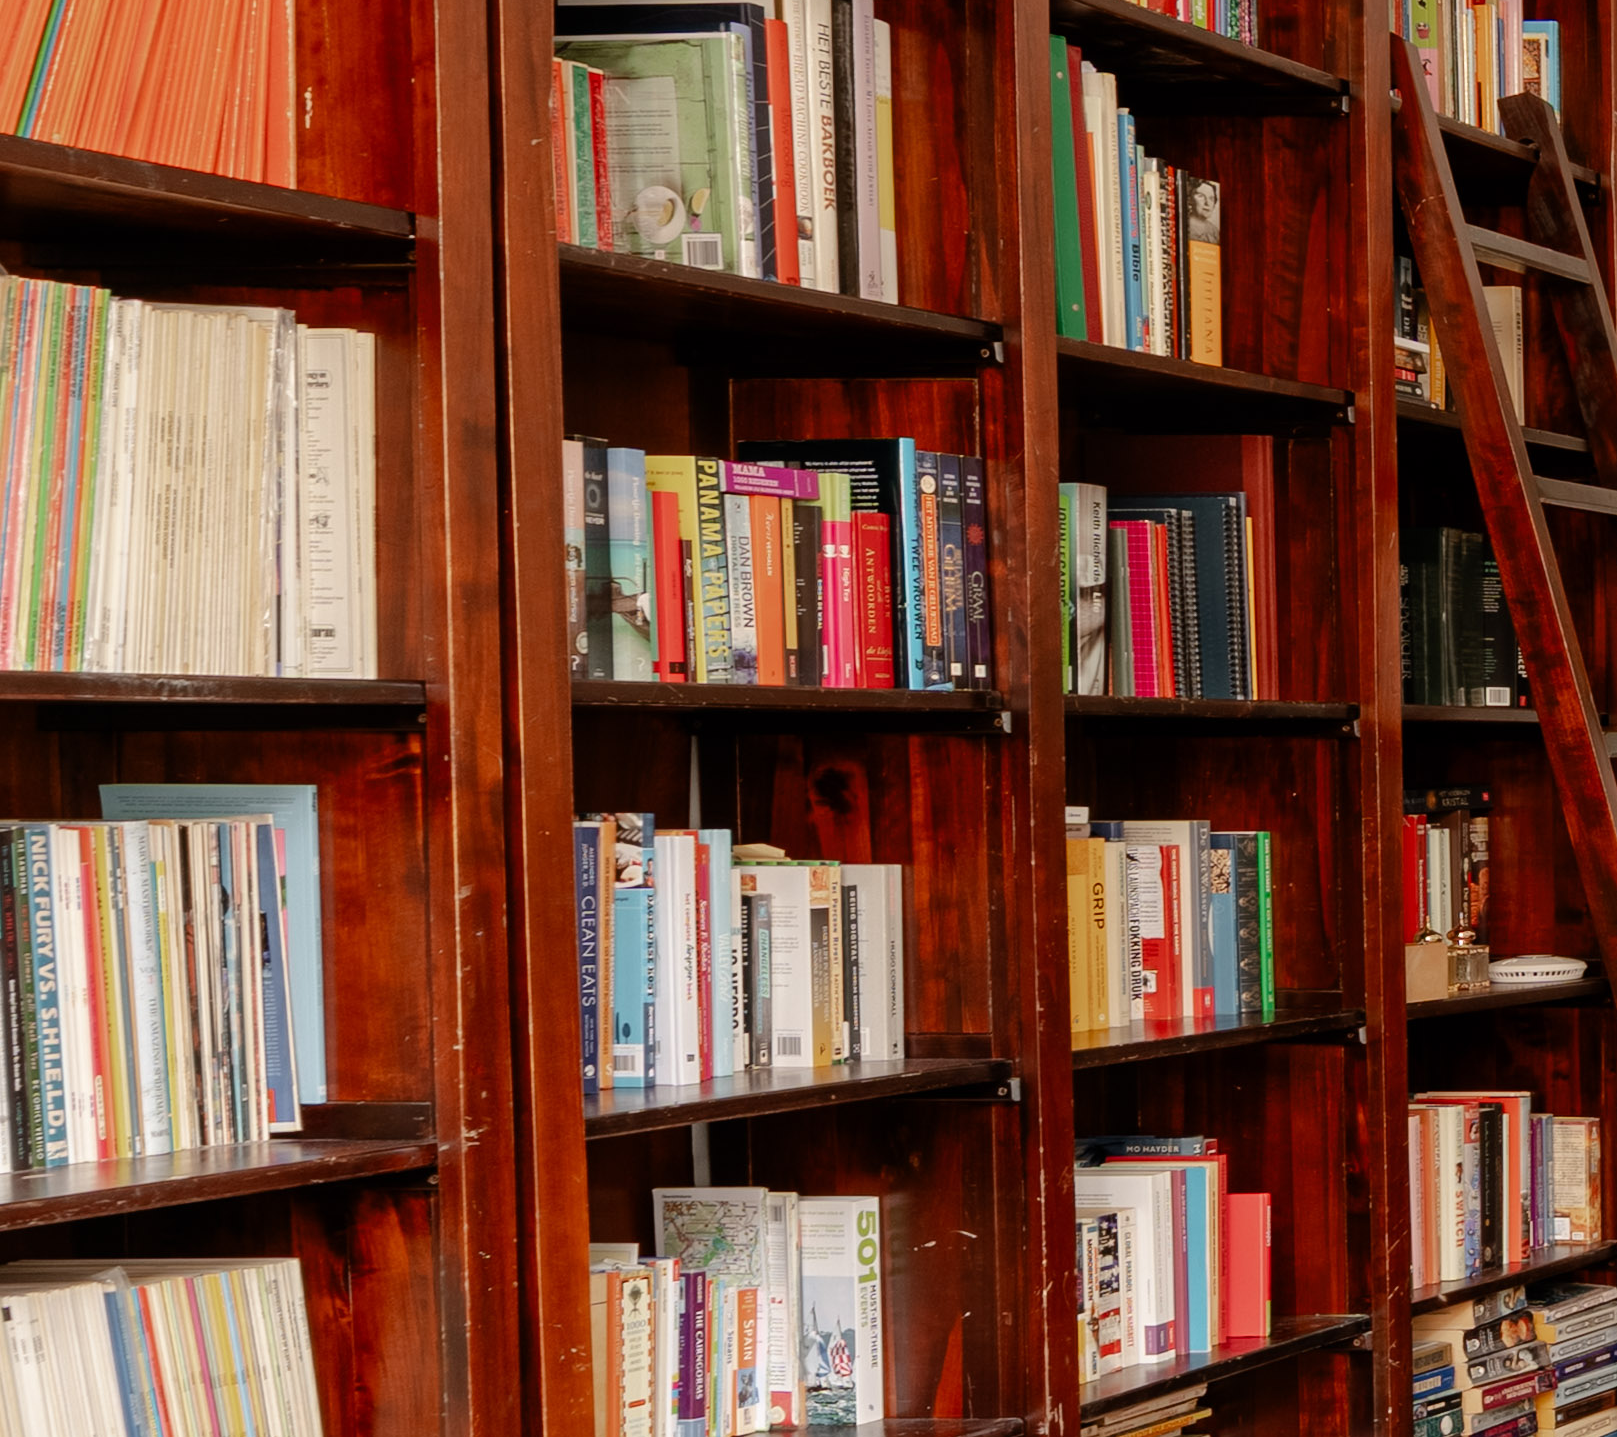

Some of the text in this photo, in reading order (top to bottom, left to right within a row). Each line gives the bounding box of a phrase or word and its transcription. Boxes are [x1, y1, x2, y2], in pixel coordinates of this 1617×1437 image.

[793, 54, 805, 92] BREAD
[795, 95, 806, 147] MACHINE
[817, 23, 836, 210] HET BESTE BAKBOEK
[797, 151, 809, 212] COOKBOOK
[1131, 244, 1141, 282] Bible
[732, 463, 766, 477] MAMA
[697, 460, 729, 657] PANAMA PAPERS
[731, 535, 742, 628] DIGITAL FORTRESS
[738, 536, 754, 628] DAN BROWN
[1093, 502, 1101, 613] Keith Richards Life
[866, 548, 876, 634] ANTWOORDEN
[1200, 828, 1207, 845] De
[1093, 882, 1105, 929] GRIP
[581, 896, 596, 1006] CLEAN EATS
[646, 894, 655, 997] DAGELIJKSE KOST
[718, 933, 729, 968] VALLEY
[760, 931, 769, 996] CHANGELESS
[1130, 920, 1141, 967] FOKKING
[31, 835, 65, 1135] NICK FURY VS. S.H.I.E.L.D.
[1131, 971, 1142, 1001] DRUK
[1126, 1145, 1180, 1153] MO HAYDER
[857, 1210, 878, 1369] 501 MUST-BE-THERE
[860, 1287, 868, 1327] EVENTS
[694, 1310, 705, 1399] THE CAIRNGORMS
[743, 1320, 755, 1361] SPAIN
